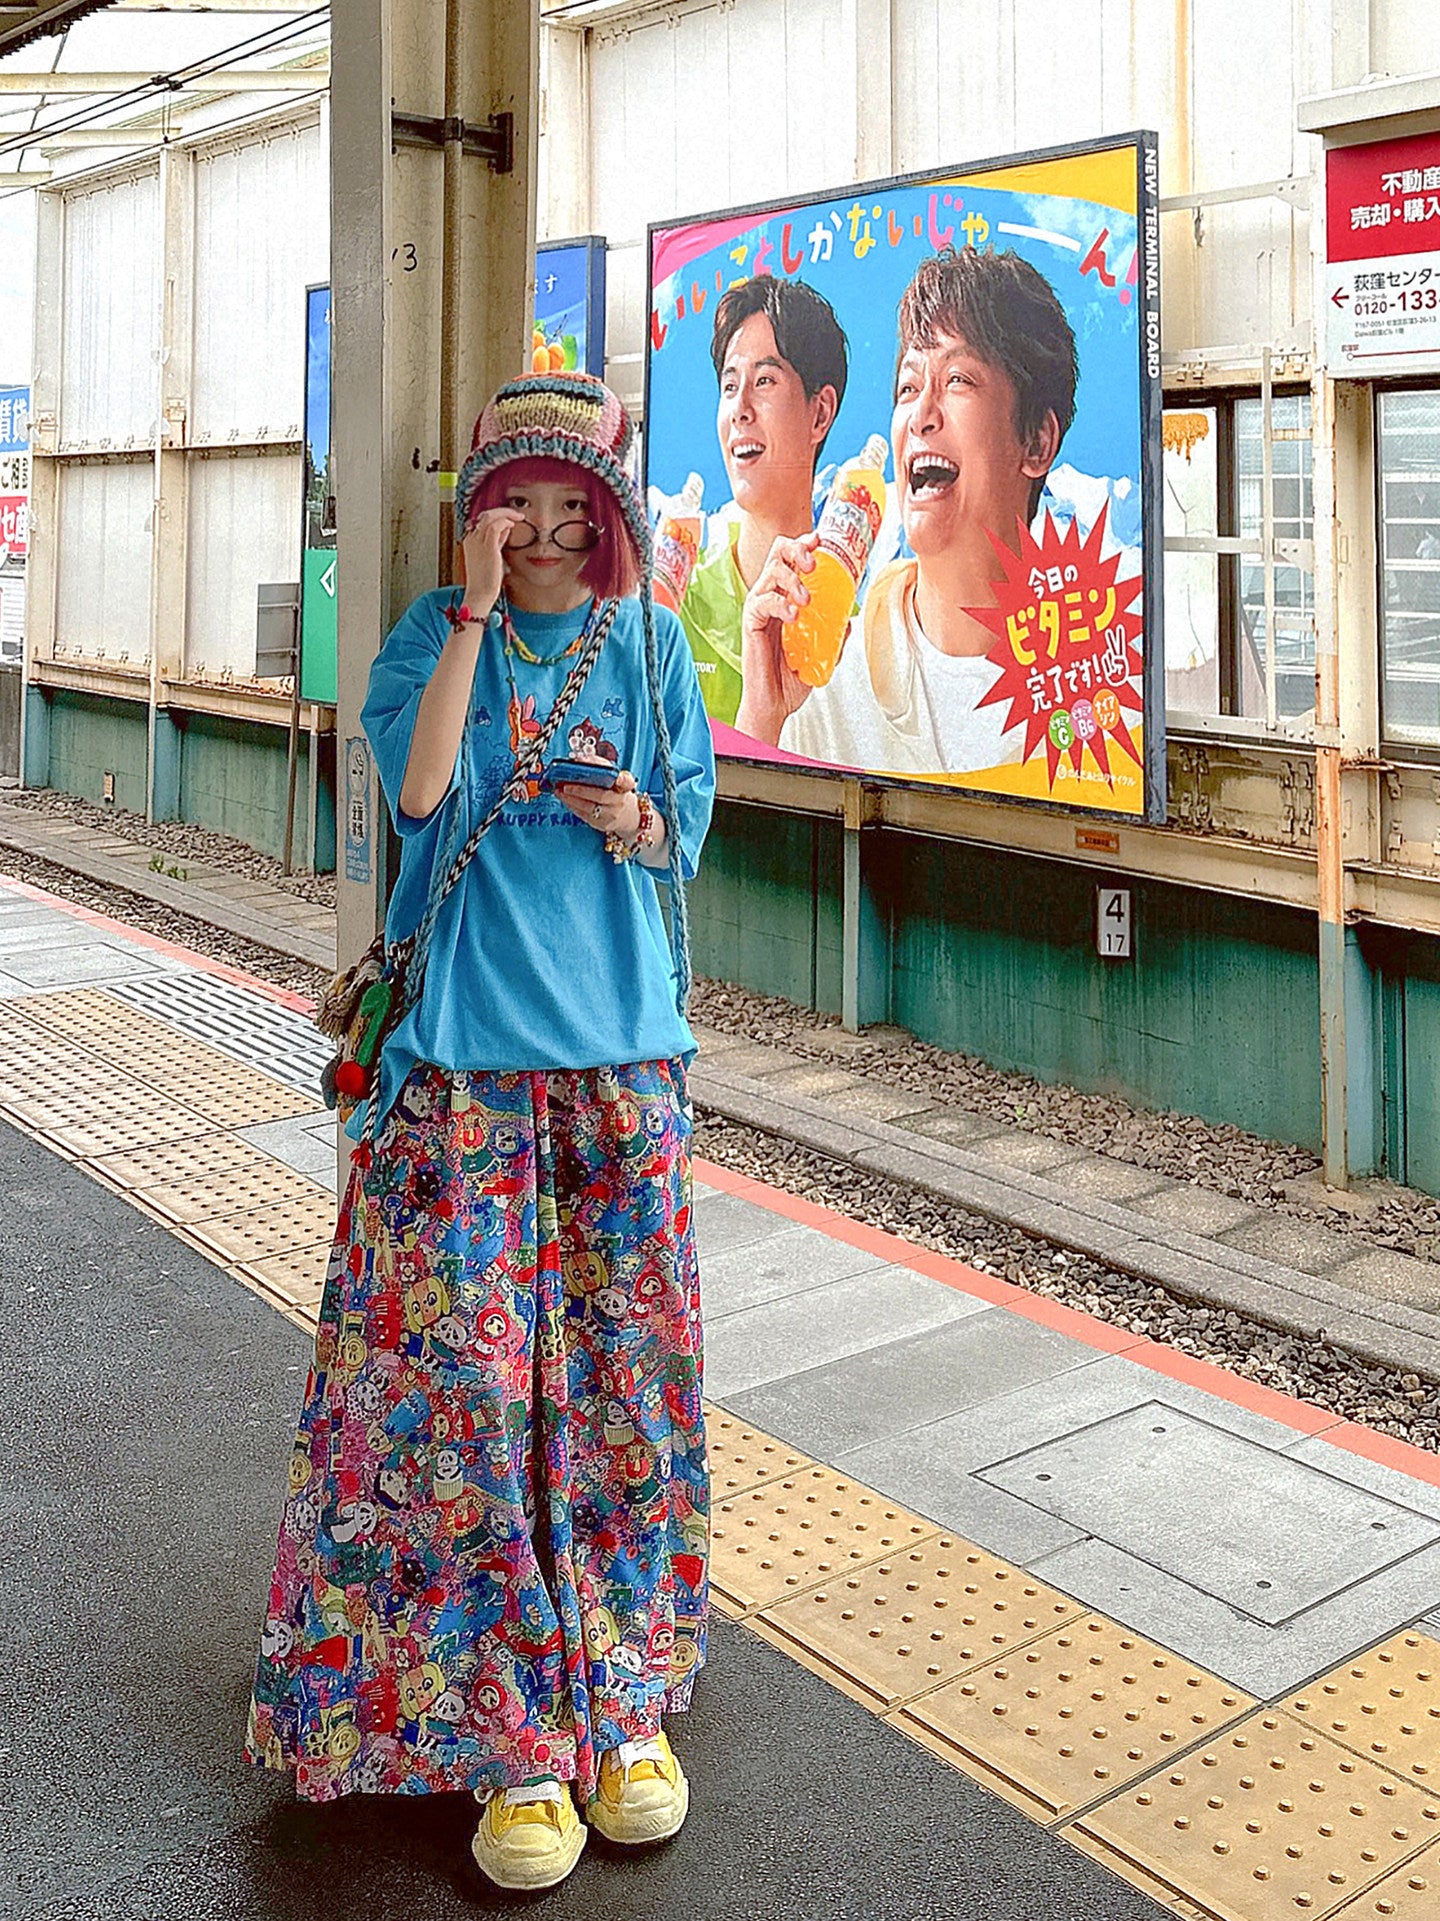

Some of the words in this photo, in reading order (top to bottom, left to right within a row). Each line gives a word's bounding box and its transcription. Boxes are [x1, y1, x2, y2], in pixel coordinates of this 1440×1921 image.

[1145, 149, 1158, 195] NEW
[1145, 206, 1158, 300] TERMINAL
[1146, 311, 1160, 379] BOARD
[1027, 564, 1079, 599] 今日の
[1006, 586, 1117, 666] ビタミン
[1105, 893, 1125, 924] 4
[1106, 933, 1125, 953] 17
